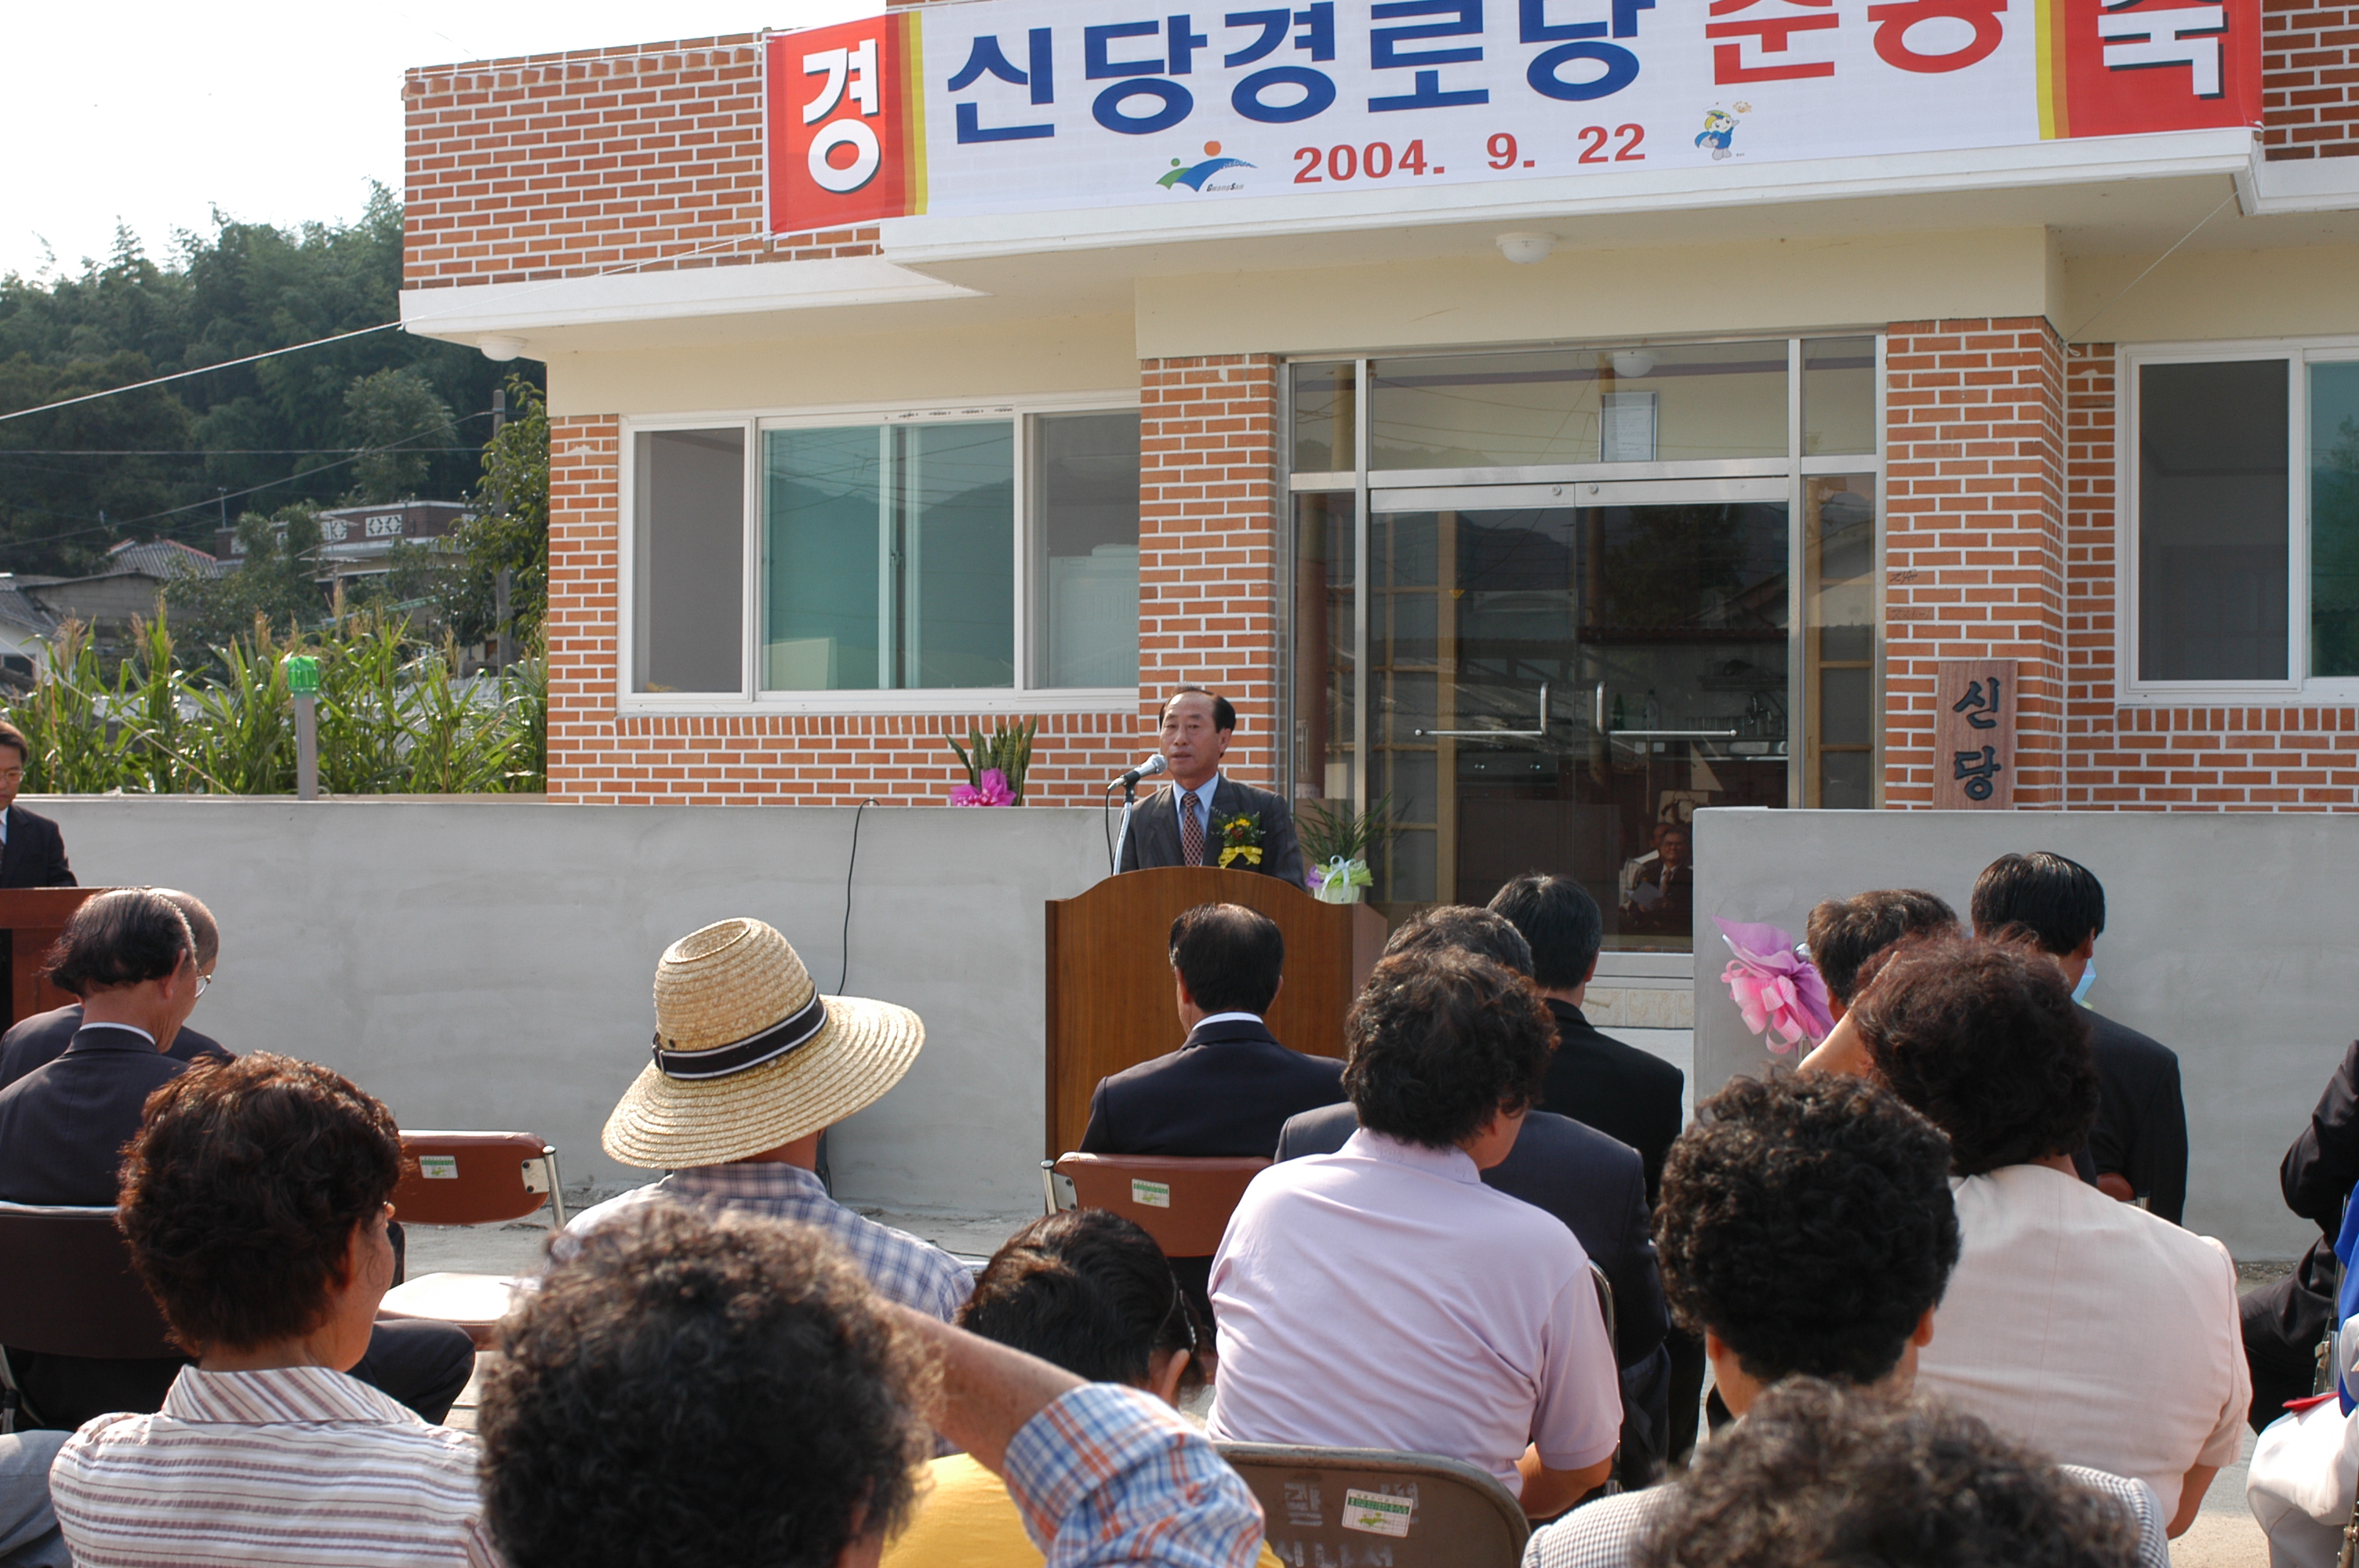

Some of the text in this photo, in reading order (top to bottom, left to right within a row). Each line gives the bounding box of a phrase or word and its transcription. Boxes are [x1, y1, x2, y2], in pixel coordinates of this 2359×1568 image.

[802, 38, 881, 194] 경
[948, 0, 1656, 144] 신당경로당
[1293, 123, 1646, 183] 2004. 9. 22
[1952, 677, 2002, 800] 신당
